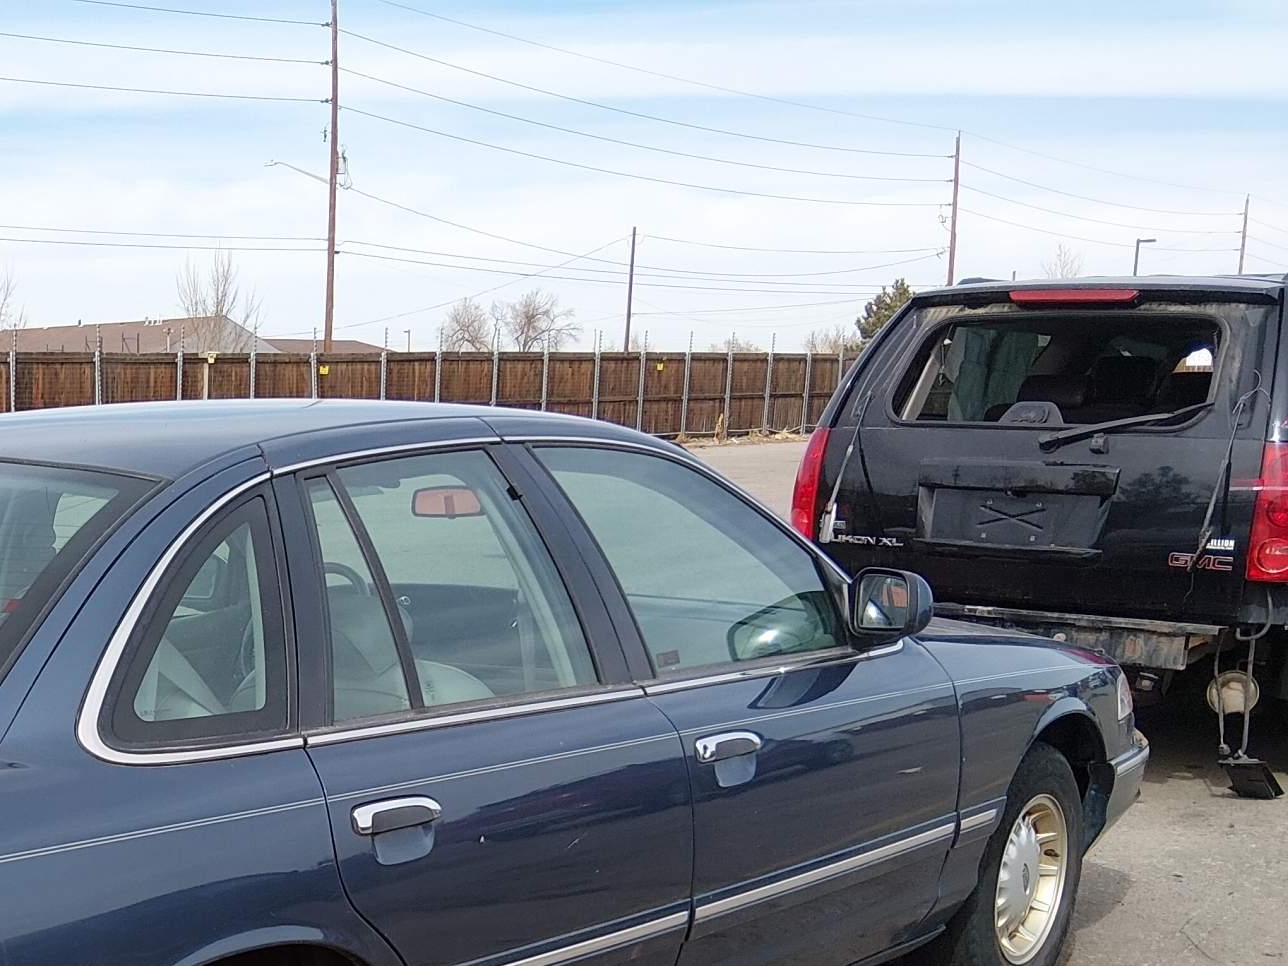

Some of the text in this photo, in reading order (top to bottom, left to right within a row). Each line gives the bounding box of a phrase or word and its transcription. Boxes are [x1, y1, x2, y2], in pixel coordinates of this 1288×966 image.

[831, 534, 904, 547] UKON XL
[1168, 551, 1234, 571] GMC
